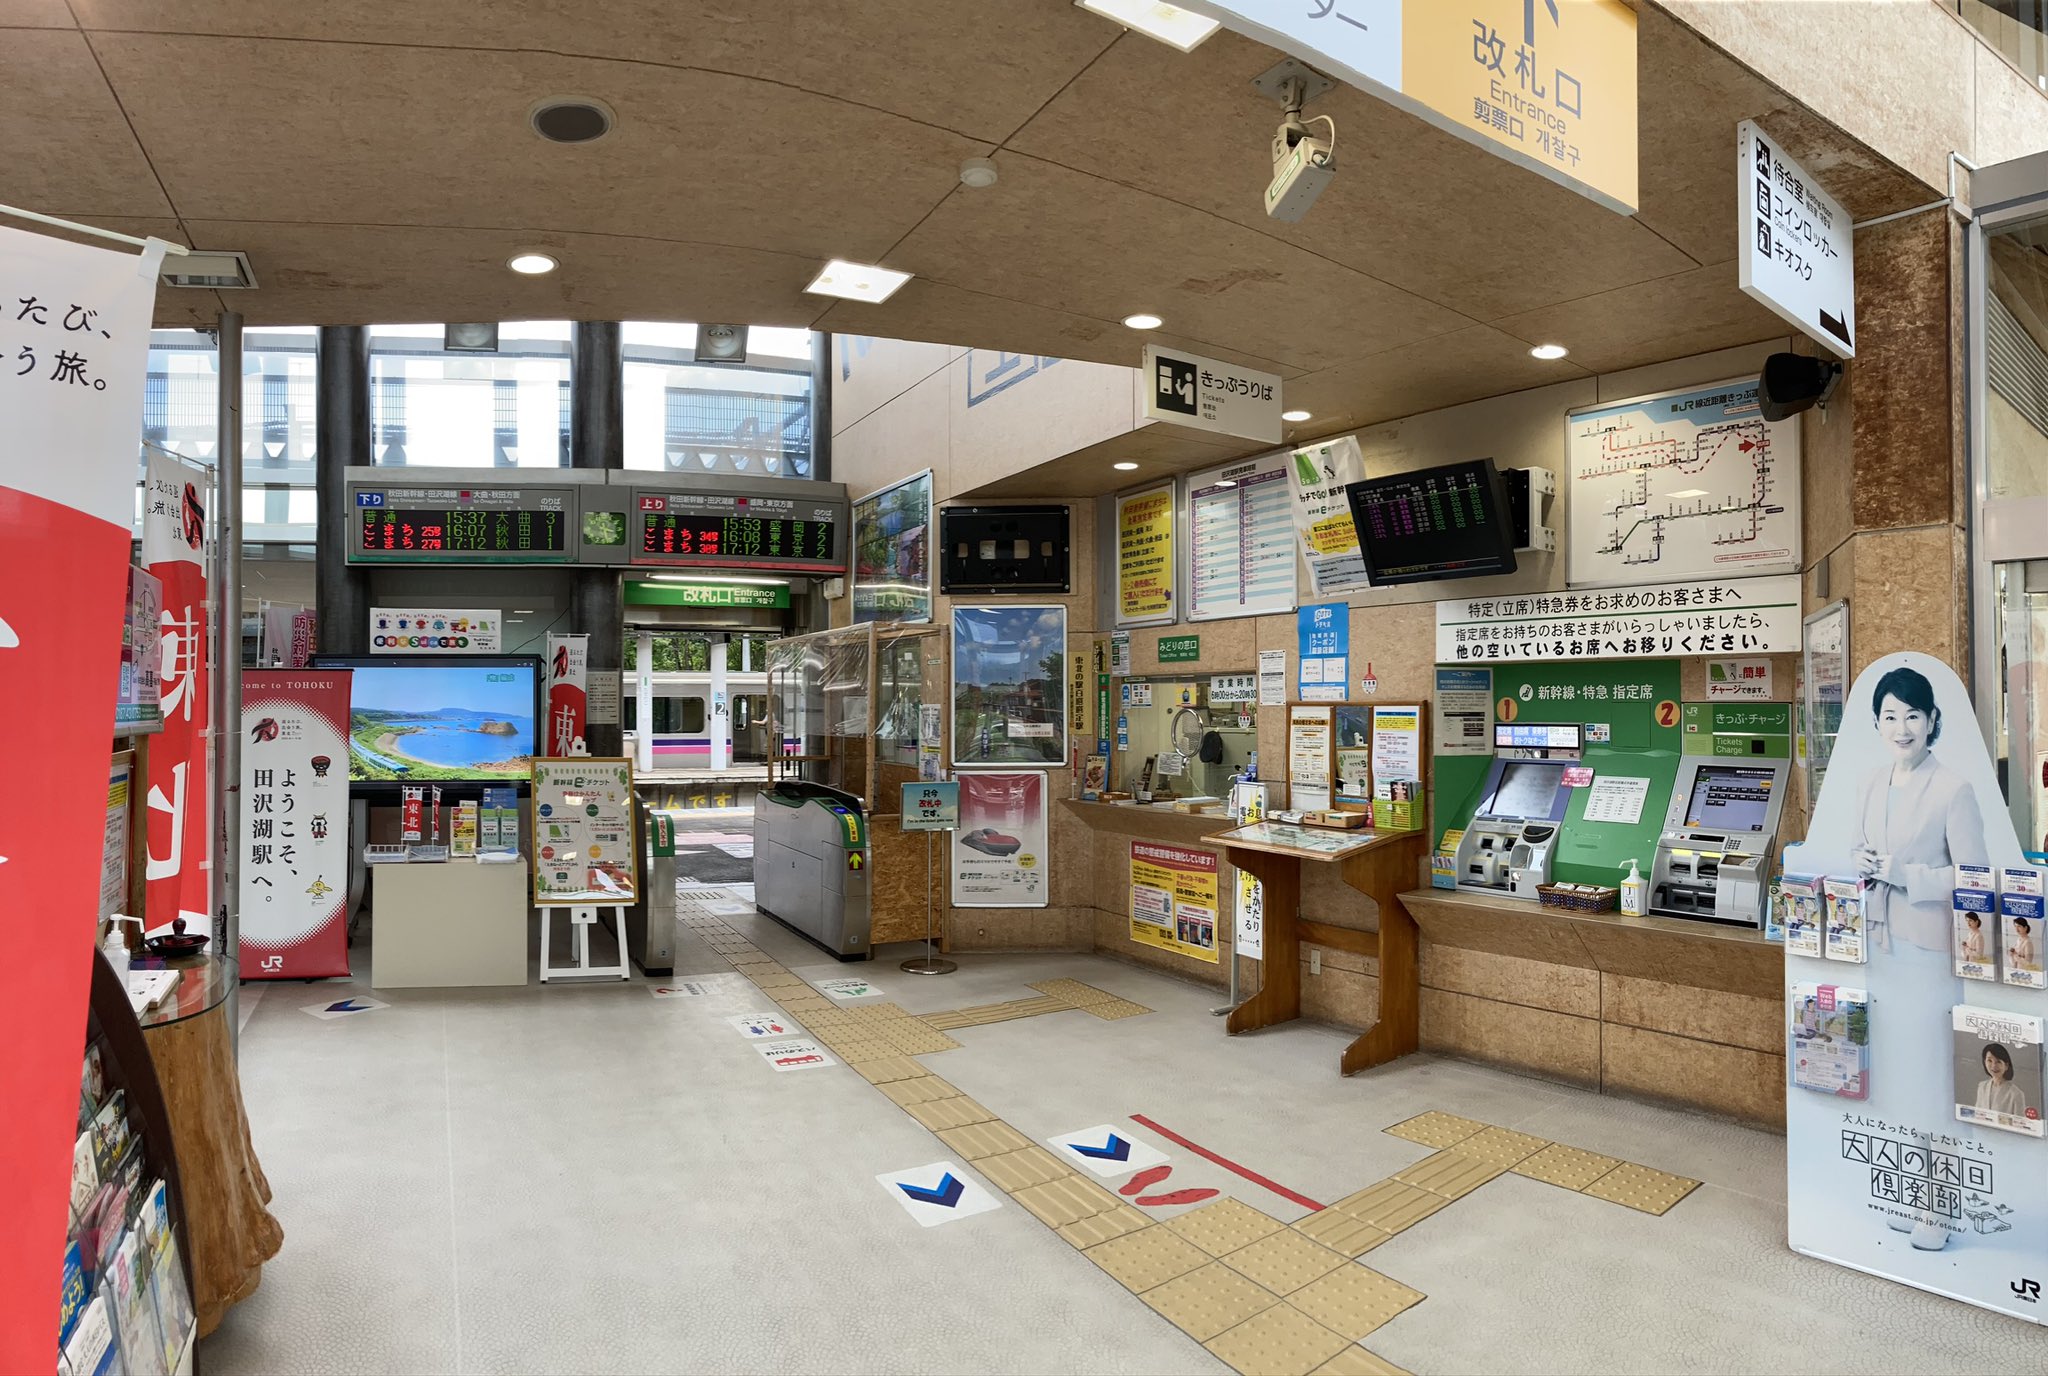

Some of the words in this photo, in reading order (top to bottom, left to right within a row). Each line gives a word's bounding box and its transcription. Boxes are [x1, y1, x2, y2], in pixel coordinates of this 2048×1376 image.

[1472, 18, 1581, 119] 改札口
[1490, 79, 1567, 135] Entrance
[1473, 97, 1524, 142] 剪票口
[1536, 127, 1581, 167] 개찰구
[1773, 159, 1804, 205] 待合室
[1775, 194, 1838, 258] コインロッカー
[1775, 239, 1813, 281] キオスク
[0, 296, 111, 339] たび、
[0, 345, 106, 391] う旅。
[1201, 370, 1273, 401] きっぷうりば
[1202, 392, 1225, 403] Tickets
[359, 494, 381, 505] 下り
[388, 490, 458, 499] 秋田新幹線・田沢湖線
[473, 490, 520, 499] 大曲・秋田方面
[669, 495, 734, 505] 秋田新幹線・田沢湖線
[750, 499, 793, 509] 盛岡・東京方面
[642, 499, 663, 510] 上り
[814, 509, 833, 517] のりば
[365, 511, 397, 524] 普通
[446, 512, 487, 524] 15:37
[496, 512, 530, 524] 大曲
[546, 512, 556, 524] 3
[646, 515, 676, 528] 普通
[724, 518, 761, 532] 15:53
[769, 520, 804, 533] 盛岡
[817, 522, 826, 534] 2
[364, 524, 414, 537] こまち
[421, 527, 441, 537] 25号
[446, 525, 487, 537] 16:07
[496, 525, 530, 537] 秋田
[548, 525, 553, 537] 1
[645, 528, 692, 540] こまち
[700, 531, 719, 542] 34号
[723, 530, 761, 543] 16:08
[769, 532, 804, 545] 東京
[817, 534, 826, 546] 2
[364, 538, 414, 549] こまち
[421, 539, 441, 550] 27号
[446, 538, 487, 550] 17:12
[496, 538, 530, 550] 秋田
[548, 538, 553, 550] 1
[644, 540, 692, 553] こまち
[723, 543, 760, 556] 17:12
[769, 545, 804, 557] 東京
[817, 546, 826, 559] 2
[683, 586, 731, 603] 改札口
[734, 588, 776, 597] Entrance
[1468, 587, 1742, 619] 特定(立席)特急券をお求めのお客さまへ
[1456, 614, 1771, 642] 指定席をお持ちのお客さまがいらっしゃいましたら、
[293, 616, 306, 669] 防災対策
[1159, 640, 1197, 652] みどりの窓口
[1312, 638, 1335, 646] クーポン
[1456, 635, 1771, 660] 他の空いているお席へお移りください。
[1743, 666, 1767, 679] 簡単
[286, 681, 334, 690] TOHOKU
[1218, 677, 1253, 689] 営業時間
[1538, 685, 1609, 700] 新幹線・特急
[1612, 684, 1654, 699] 指定席
[1711, 684, 1766, 695] チャージできます。
[716, 703, 725, 715] 2
[1504, 699, 1511, 720] 1
[1661, 703, 1674, 726] 2
[1716, 713, 1786, 726] きっぷ・チャージ
[554, 704, 576, 757] 東
[1716, 737, 1743, 746] Tickets
[1716, 746, 1743, 755] Charge
[923, 789, 939, 798] 只今
[918, 799, 942, 808] 改札中
[408, 803, 418, 828] 東北
[922, 809, 940, 818] です。
[279, 769, 298, 877] ようこそ、
[251, 768, 274, 902] 田沢湖駅へ。
[261, 955, 283, 969] JR
[1966, 1015, 2022, 1036] 大人の休日
[765, 1046, 816, 1057] バスのりば
[1842, 1112, 1994, 1156] 大人になったら、したいこと。
[1842, 1130, 1993, 1194] 大人の休日
[1871, 1168, 1962, 1219] 倶楽部
[1867, 1202, 1967, 1235] www.jreast.co.jp/otona/
[2010, 1279, 2041, 1298] JR
